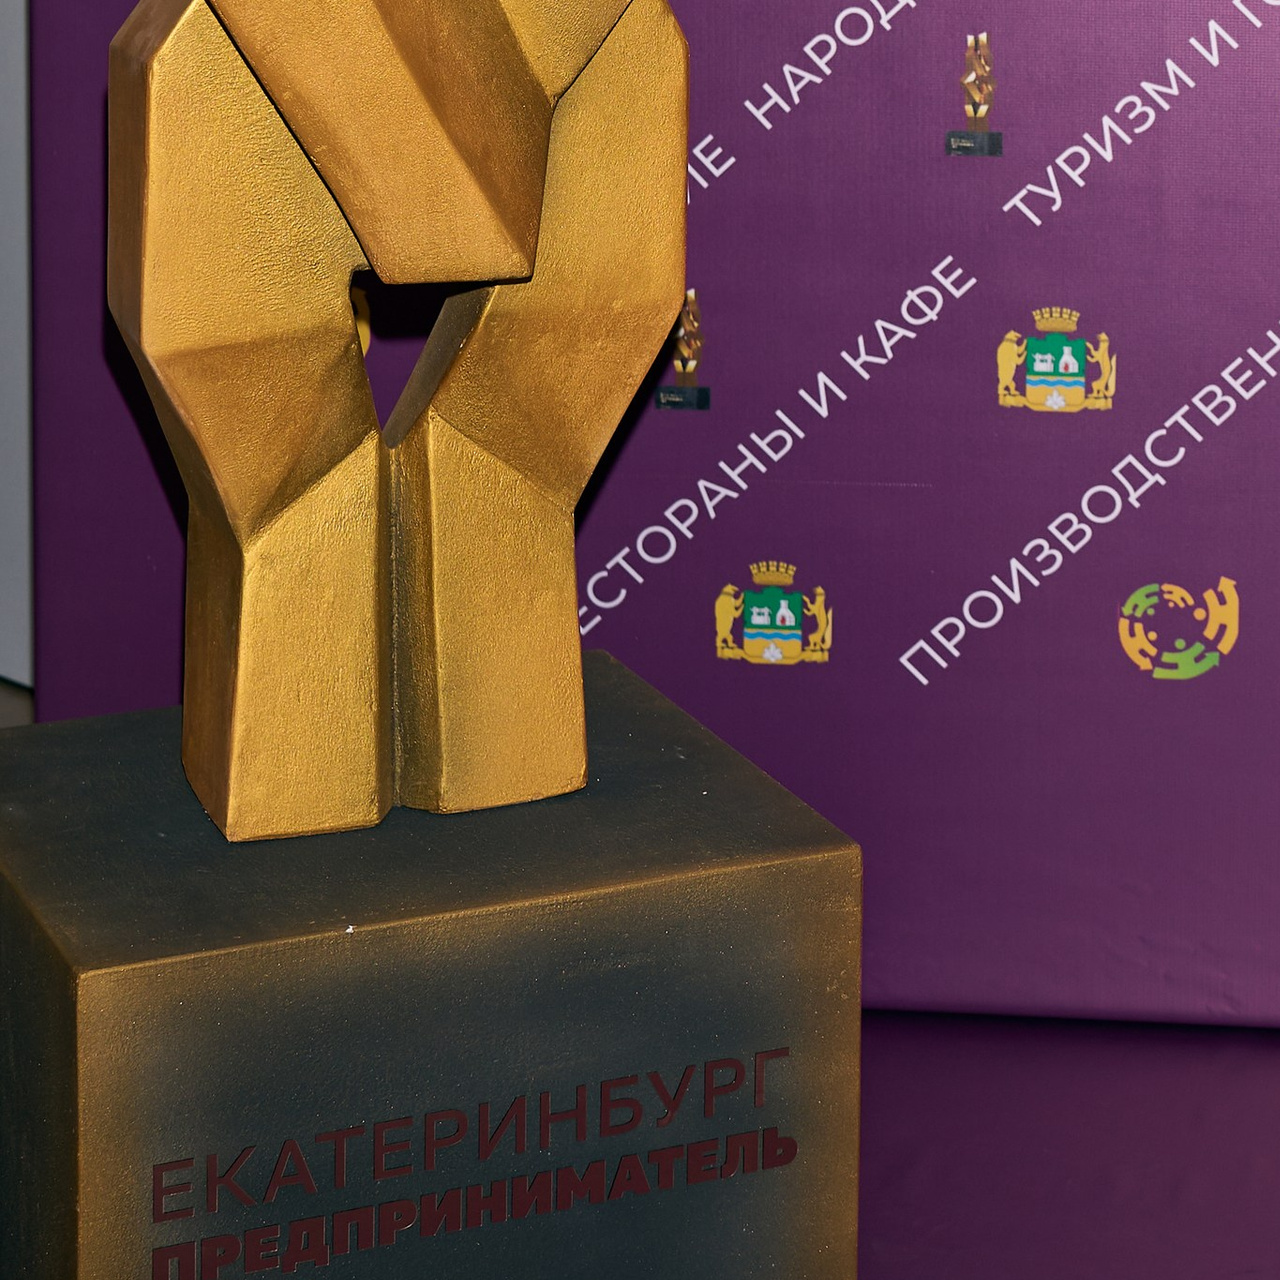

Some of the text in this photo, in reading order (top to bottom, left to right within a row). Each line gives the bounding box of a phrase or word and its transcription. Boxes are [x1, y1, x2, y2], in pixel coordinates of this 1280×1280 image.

[1002, 58, 1196, 227] ТУРИЗМ
[1188, 19, 1239, 67] И
[581, 255, 977, 634] СТОРАНЫ И КАФЕ
[152, 1047, 791, 1223] ЕКАТЕРИНБУРГ
[152, 1126, 799, 1280] ПРЕДПРИНИМАТЕЛЬ
